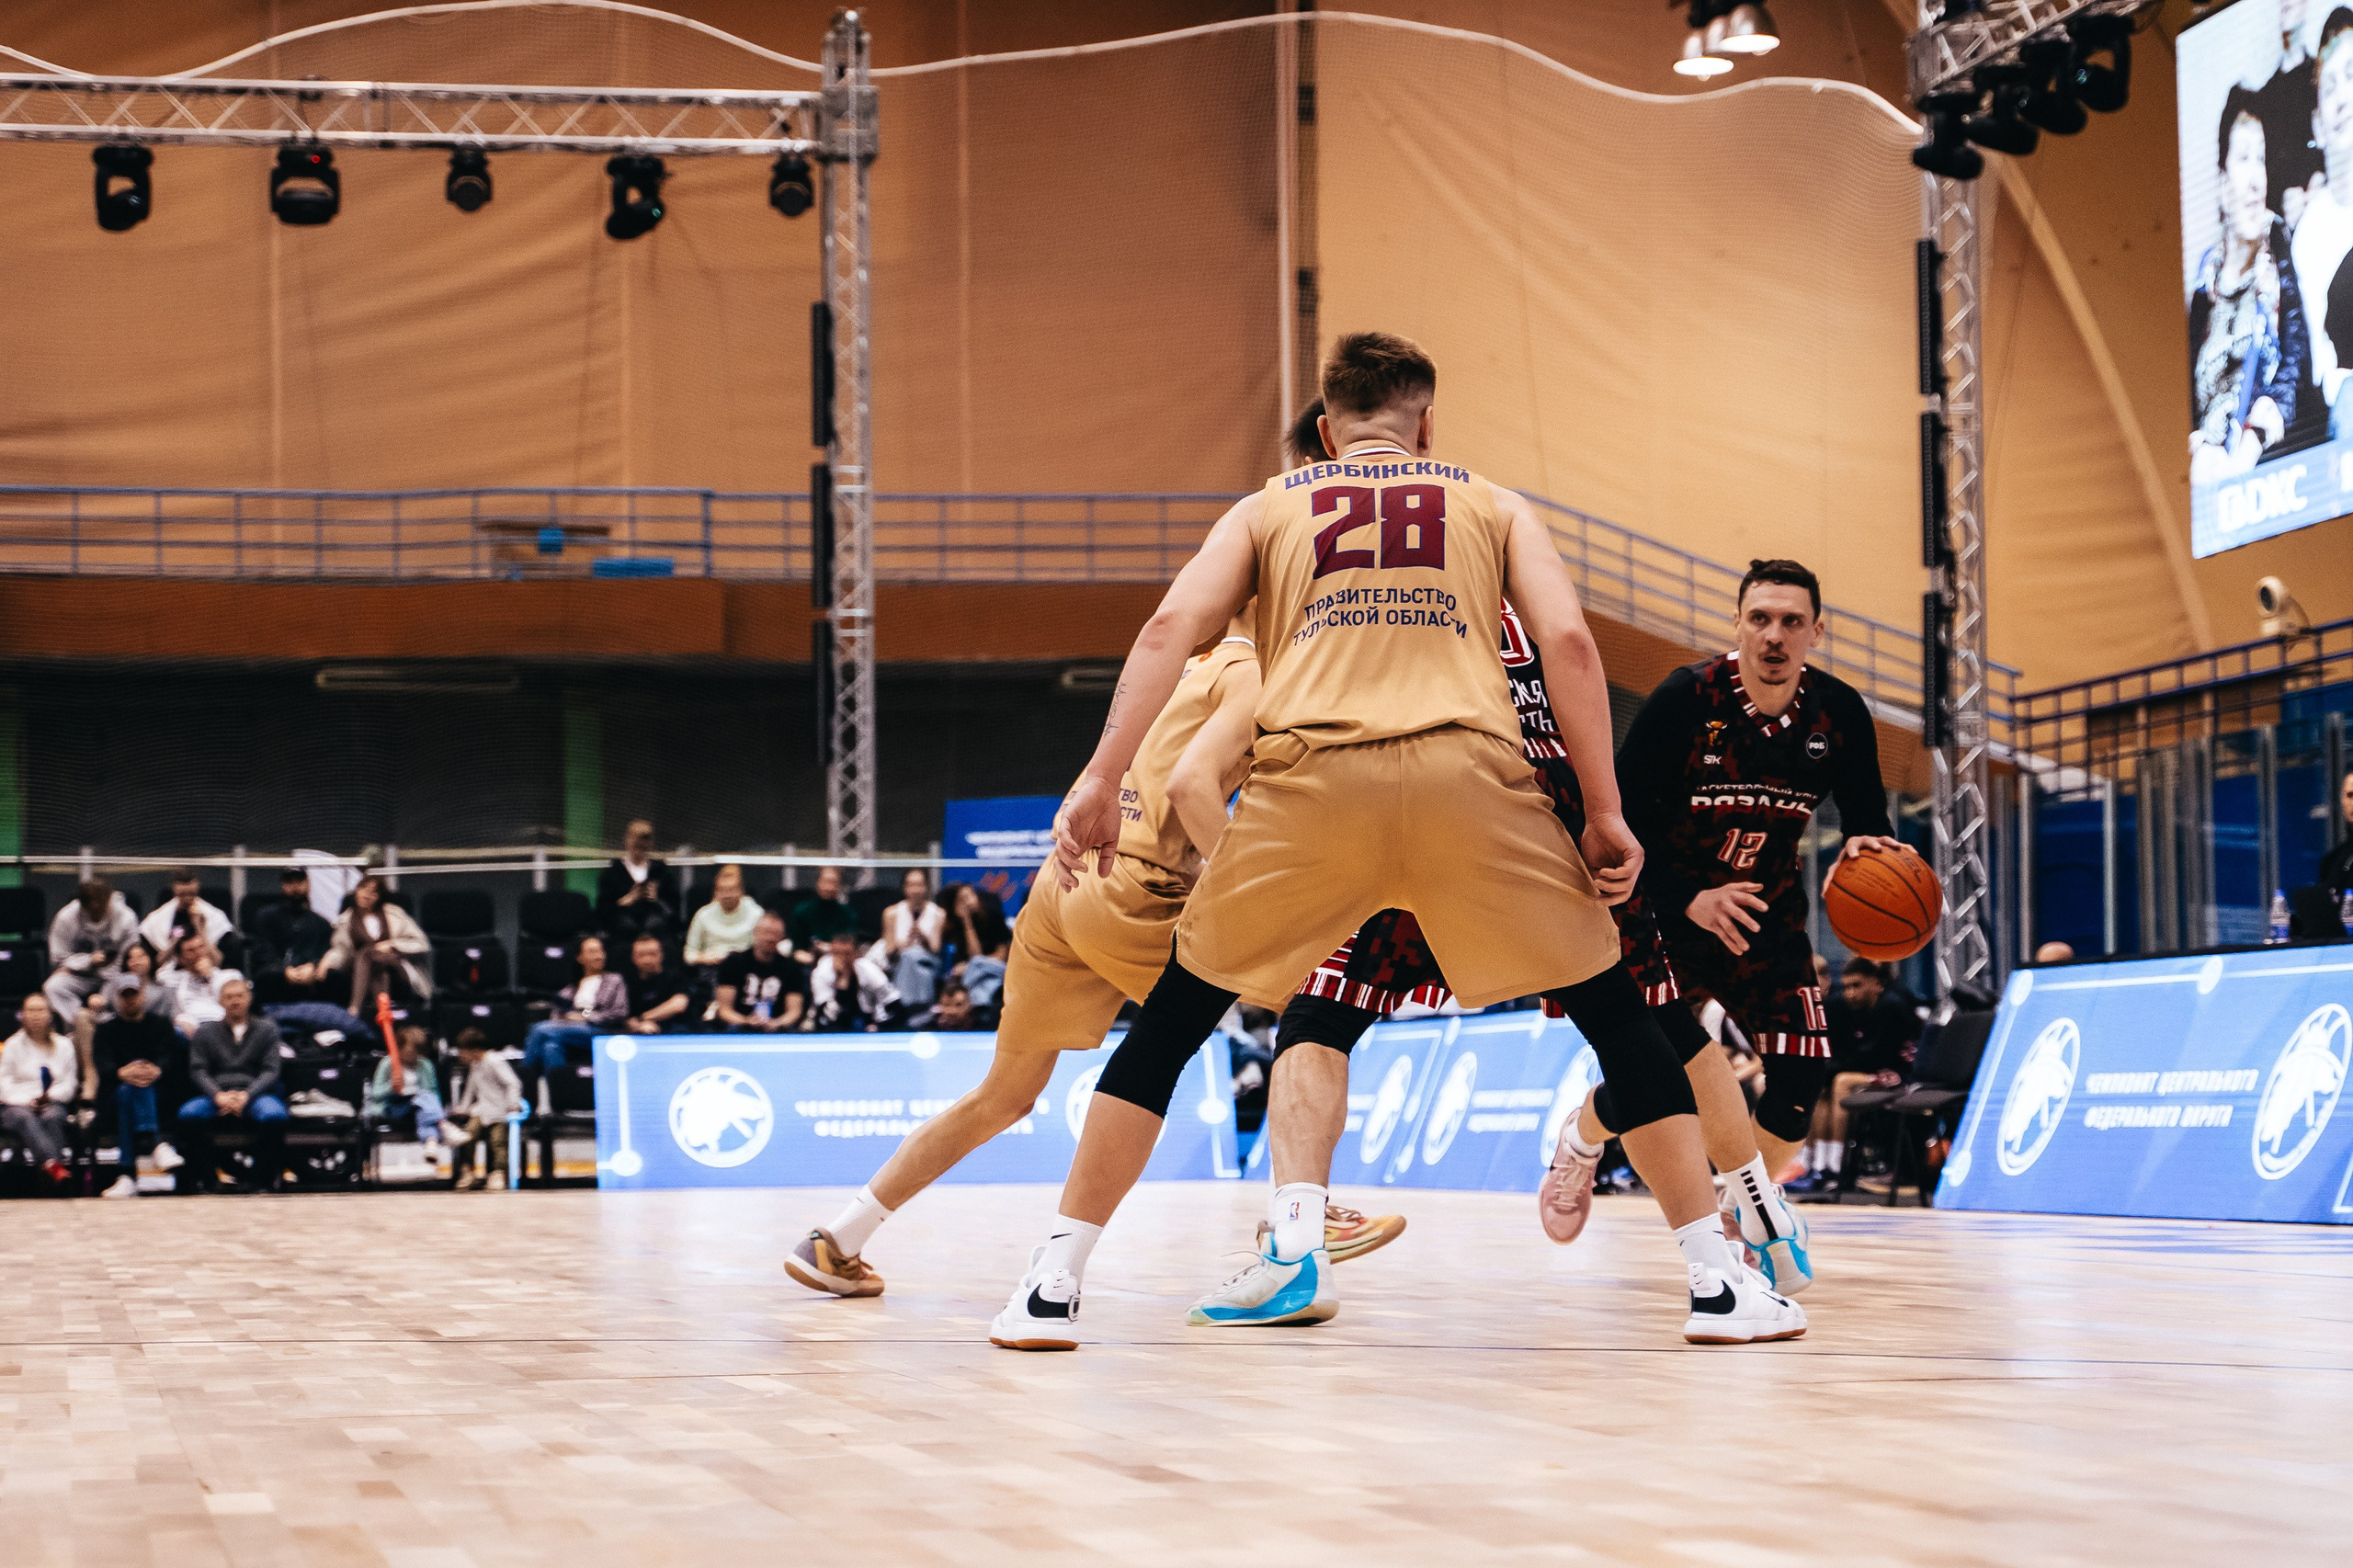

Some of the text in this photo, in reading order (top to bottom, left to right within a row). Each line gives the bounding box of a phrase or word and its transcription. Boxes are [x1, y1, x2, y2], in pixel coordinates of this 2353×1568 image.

[1285, 461, 1470, 490] ЩЕРБИНСКИЙ
[1311, 483, 1446, 580] 28
[1304, 587, 1457, 621] ПРАВИТЕЛЬСТВО
[1716, 827, 1768, 871] 12
